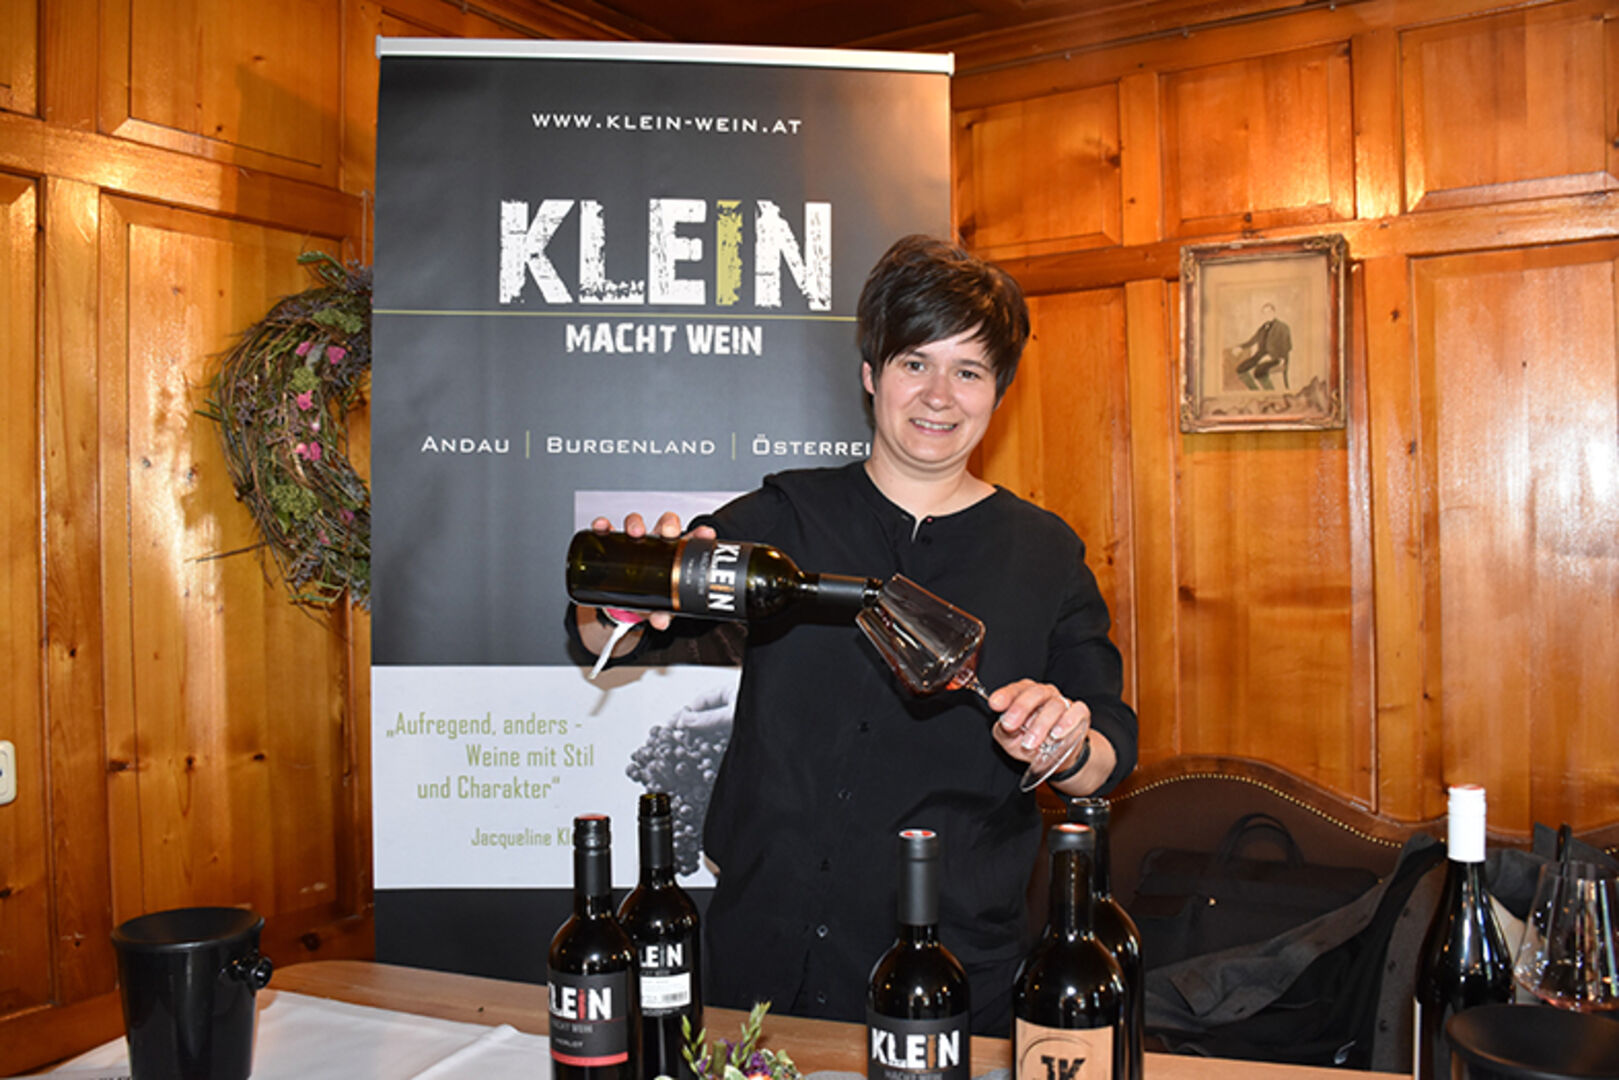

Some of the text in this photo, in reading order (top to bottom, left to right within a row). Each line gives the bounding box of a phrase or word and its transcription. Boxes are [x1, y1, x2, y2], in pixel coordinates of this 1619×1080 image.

[532, 113, 803, 135] WWW.KLEIN-WEIN.AT
[499, 198, 832, 311] KLEIN
[566, 322, 762, 356] MACHT WEIN
[421, 435, 510, 454] ANDAU
[546, 436, 716, 455] BURGENLAND
[708, 543, 740, 611] KLEIN
[503, 711, 568, 735] anders
[466, 743, 594, 767] Weine mit Stil
[417, 776, 451, 799] und
[471, 827, 552, 849] Jacqueline
[871, 1027, 960, 1070] KLEIN
